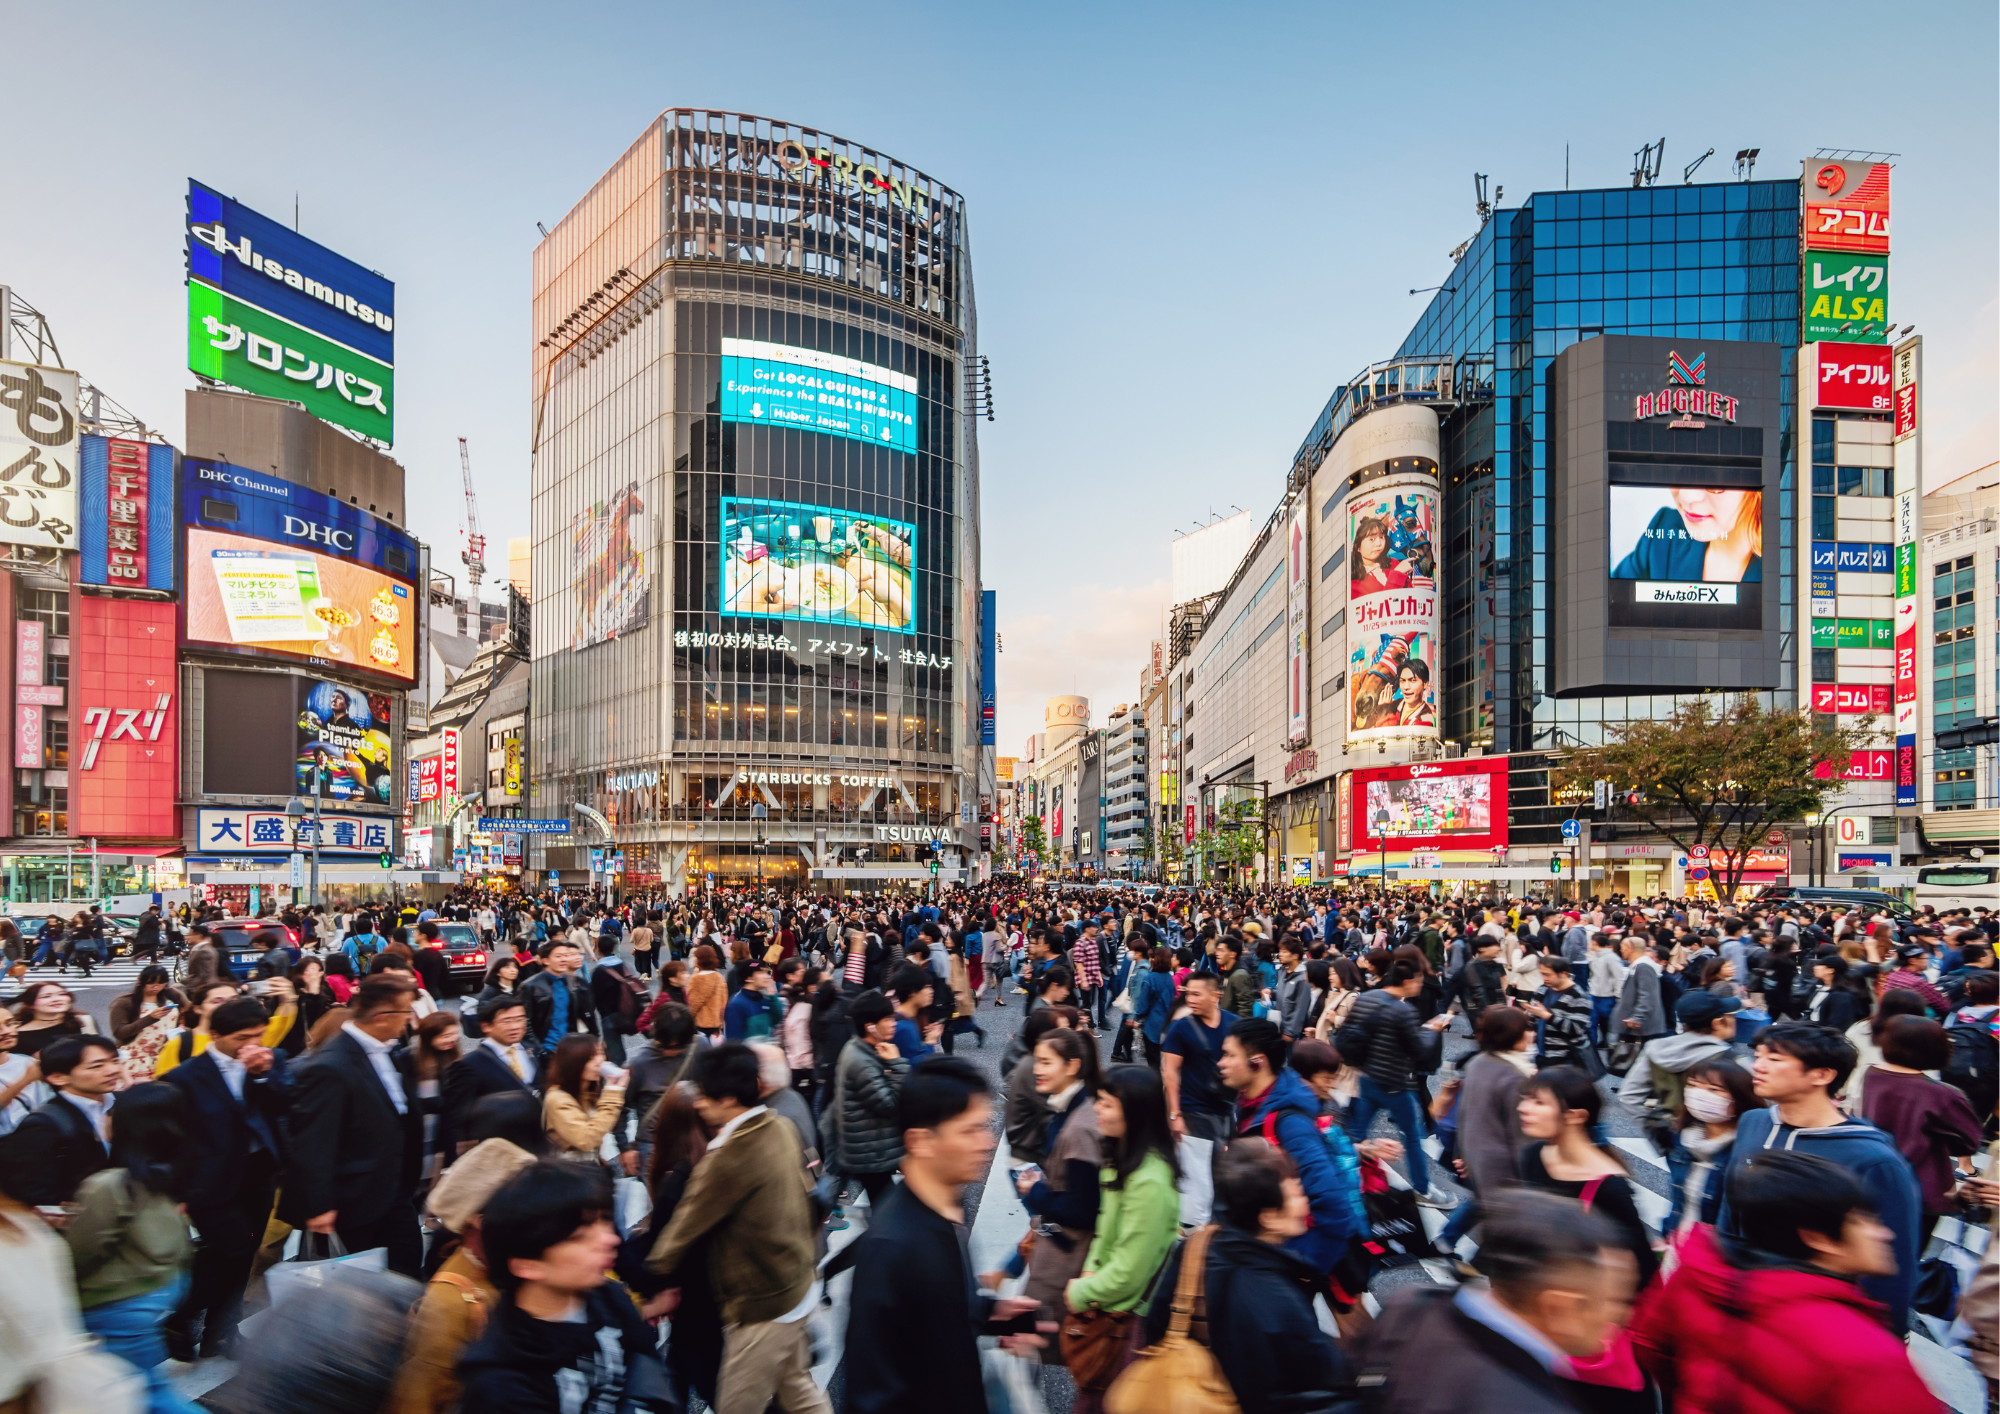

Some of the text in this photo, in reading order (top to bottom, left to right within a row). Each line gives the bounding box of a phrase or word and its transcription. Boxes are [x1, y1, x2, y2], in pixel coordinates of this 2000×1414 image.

[777, 139, 928, 215] QFRONT
[1817, 208, 1890, 236] アコム
[191, 224, 393, 332] Hisamitsu
[1813, 262, 1884, 292] レイク
[1810, 294, 1884, 321] ALSA
[202, 314, 388, 415] サロンパス
[1820, 363, 1891, 385] アイフル
[753, 368, 888, 404] Get LOCAL GUIDES &
[727, 380, 913, 425] Experience the REAL SHIBUYA
[1636, 388, 1739, 423] MAGNET
[1872, 396, 1890, 408] 8F
[1900, 396, 1913, 434] アイフル
[816, 415, 850, 432] Japan
[0, 367, 73, 544] もんじゃ
[199, 467, 289, 498] DHC Channel
[108, 441, 139, 578] 三千里薬品
[284, 514, 352, 551] DHC
[1901, 545, 1911, 593] レイク ALSA
[226, 580, 297, 590] マルチビタミン
[1654, 587, 1719, 602] みんなのFX
[1355, 595, 1435, 624] ジャパンカップ
[1812, 625, 1891, 639] レイク ALSA 5F
[309, 657, 329, 666] DHC
[1899, 648, 1913, 680] アコム
[1818, 691, 1868, 706] アコム
[80, 693, 171, 770] クスリ
[318, 729, 374, 751] Planets
[326, 722, 360, 737] teamLab
[332, 758, 362, 769] TOYOSU
[336, 746, 360, 756] TOKYO
[445, 735, 457, 783] カラオケ
[1081, 740, 1099, 761] ZARA
[738, 772, 893, 788] STARBUCKS COFFEE
[1284, 750, 1317, 784] MAGNET
[1410, 765, 1442, 778] Glico
[1900, 746, 1913, 787] PROMISE
[330, 785, 365, 796] DMM.com
[210, 817, 386, 847] 大盛堂書店
[877, 826, 951, 842] TSUTAYA
[1841, 818, 1864, 841] 0円
[1624, 845, 1655, 856] MAGNET
[1842, 859, 1874, 867] PROMISE
